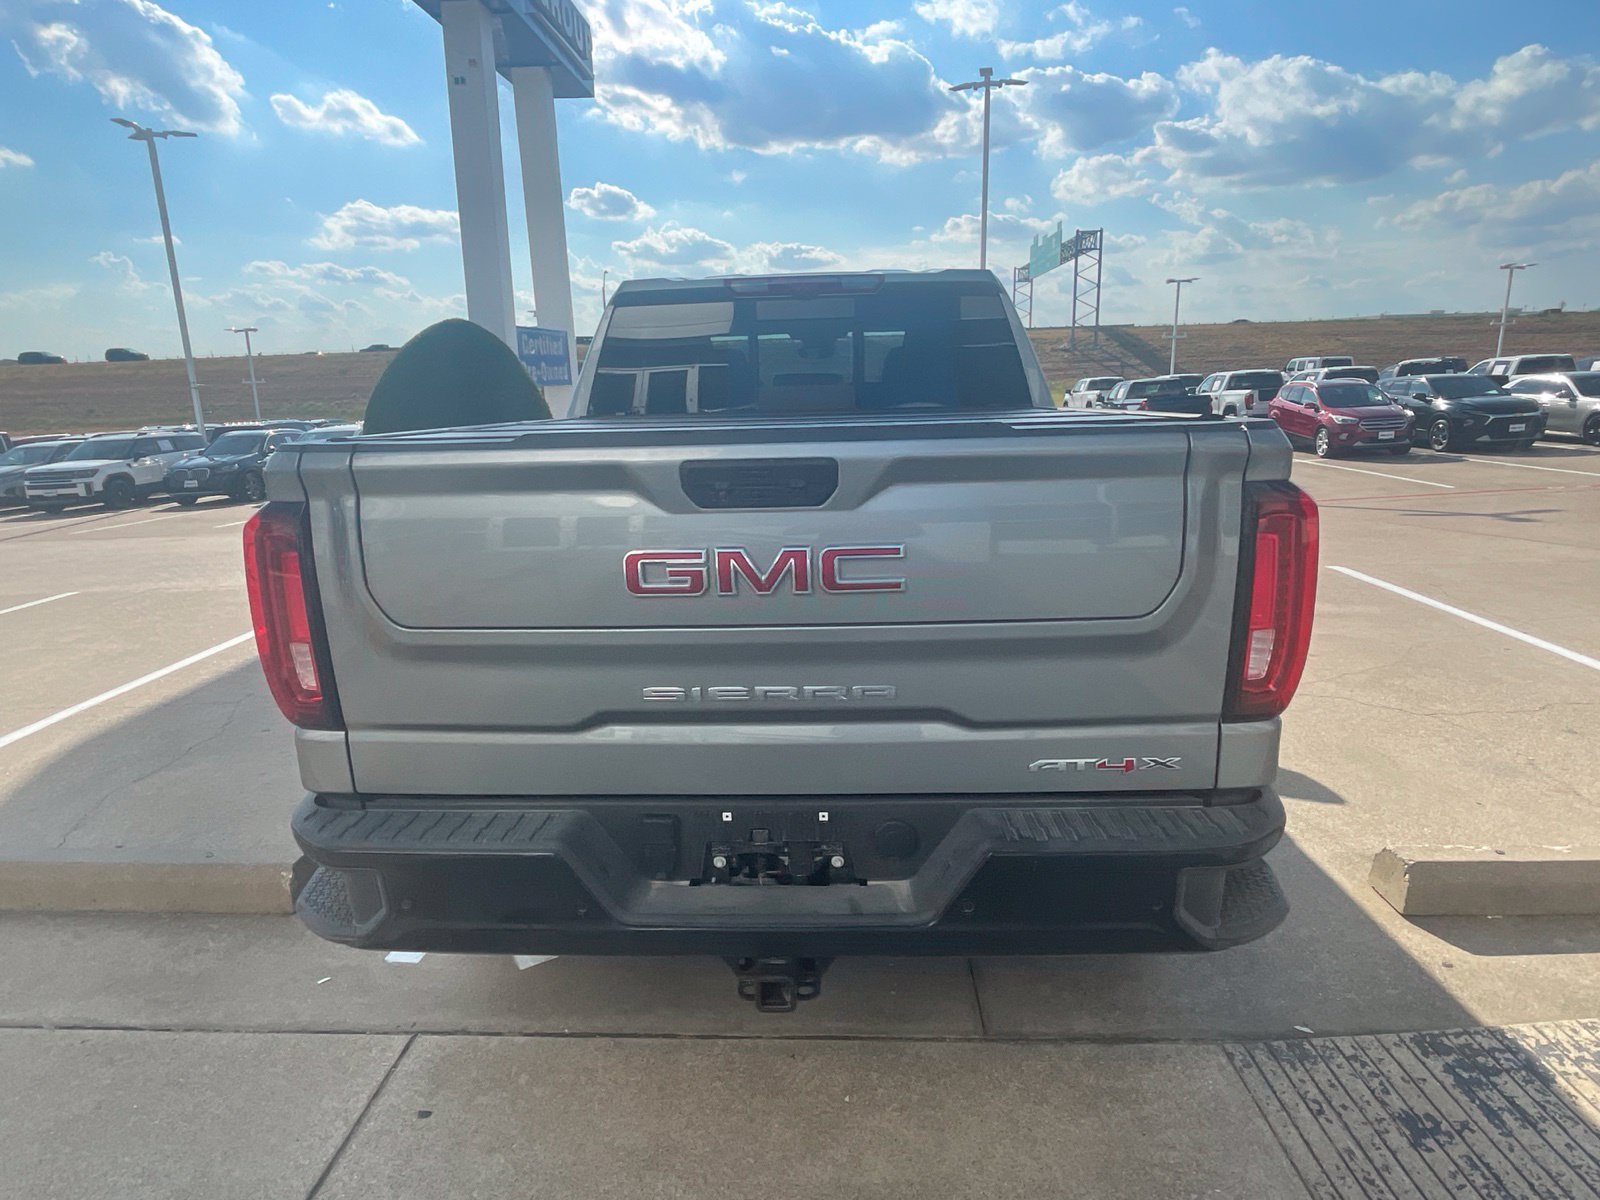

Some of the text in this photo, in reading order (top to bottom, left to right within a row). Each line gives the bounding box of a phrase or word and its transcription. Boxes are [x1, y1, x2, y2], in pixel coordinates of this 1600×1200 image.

[623, 544, 906, 597] GMC
[642, 685, 897, 701] SIERRA
[1029, 757, 1182, 773] AT4X
